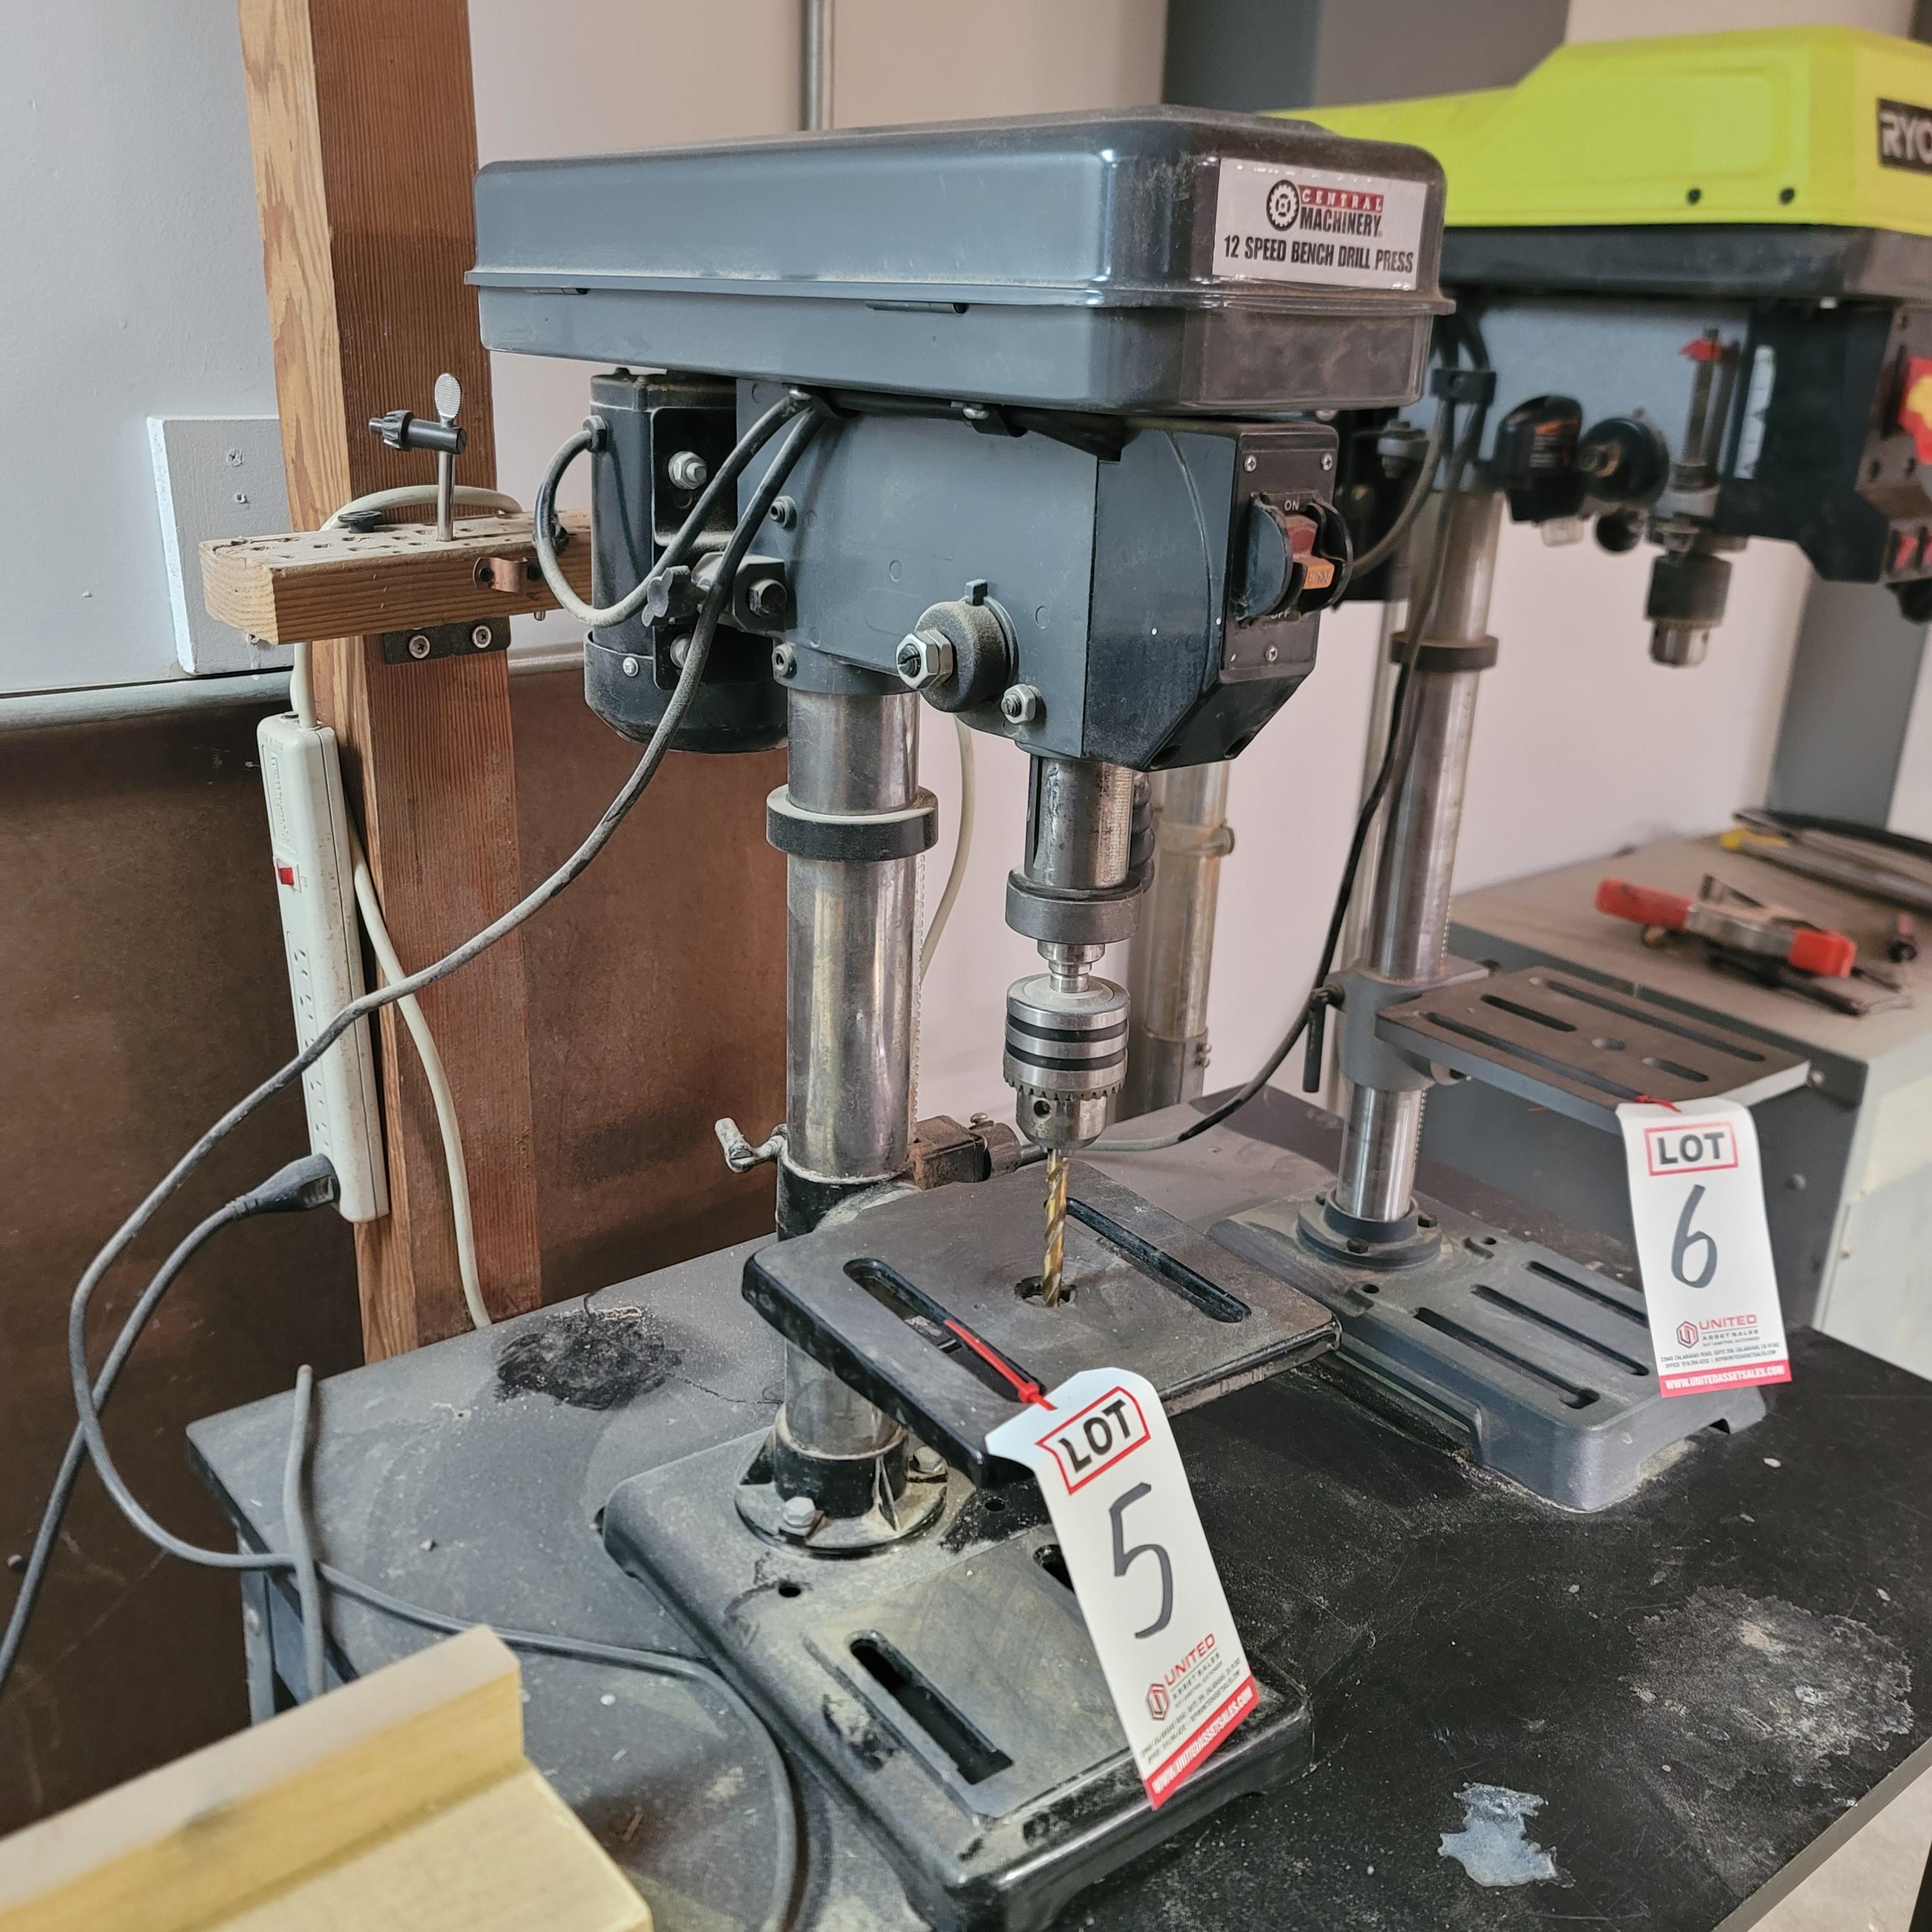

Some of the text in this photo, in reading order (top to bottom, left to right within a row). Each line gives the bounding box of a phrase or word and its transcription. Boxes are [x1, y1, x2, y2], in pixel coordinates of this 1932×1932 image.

[1300, 188, 1382, 212] CENTRAL
[1299, 207, 1382, 238] MACHINERY
[1224, 234, 1414, 273] 12 SPEED BENCH DRILL PRESS
[1284, 499, 1299, 511] ON
[1656, 1131, 1725, 1166] LOT
[1670, 1184, 1718, 1289] 6
[1699, 1313, 1757, 1330] UNITED
[1702, 1329, 1759, 1341] ASSET SALES
[1665, 1364, 1785, 1390] WWW.UNITEDASSETSALES.COM
[1058, 1398, 1132, 1474] LOT
[1108, 1482, 1174, 1639] 5
[1164, 1633, 1216, 1686] UNITED
